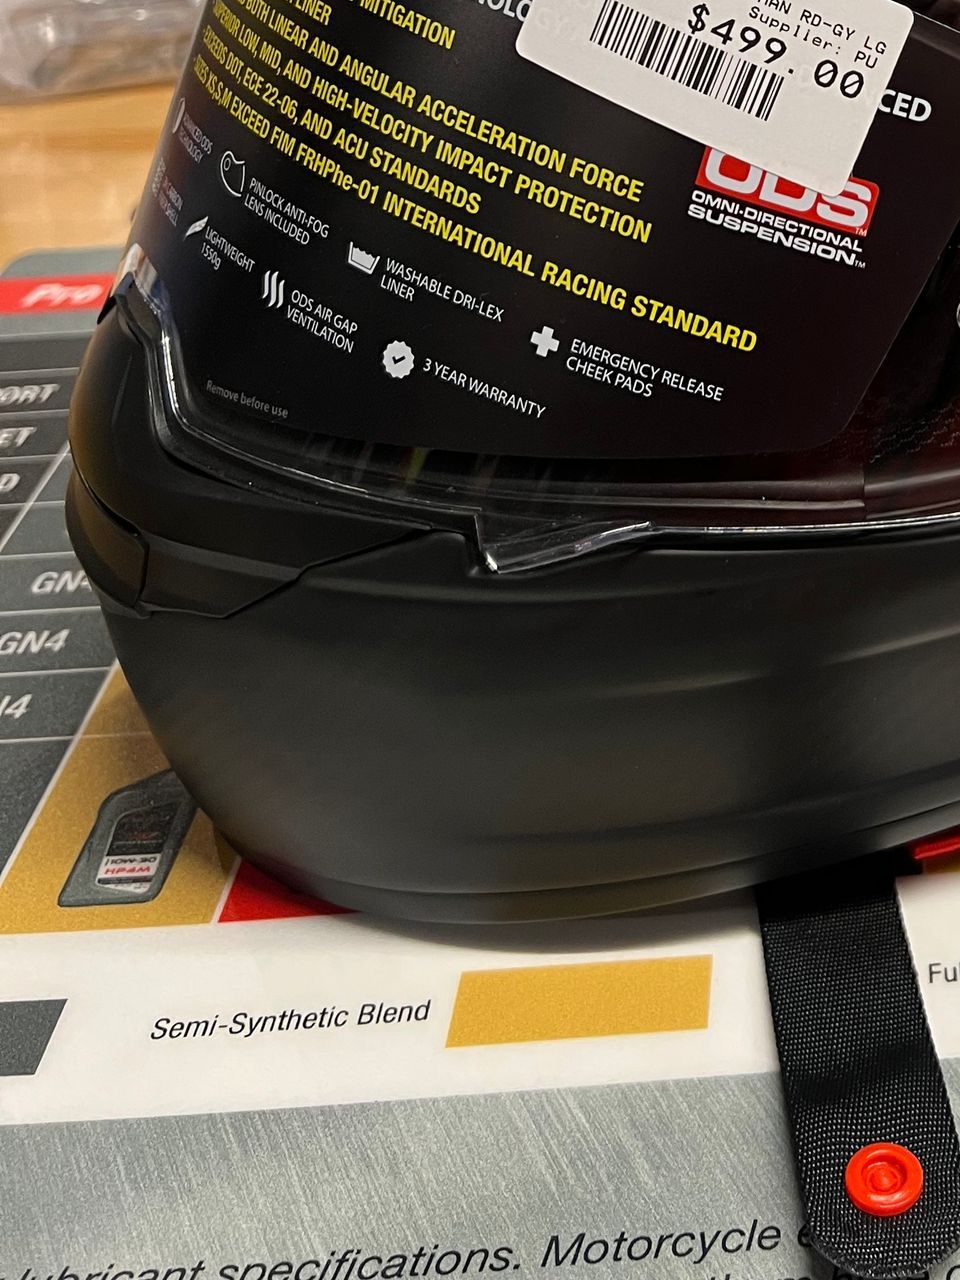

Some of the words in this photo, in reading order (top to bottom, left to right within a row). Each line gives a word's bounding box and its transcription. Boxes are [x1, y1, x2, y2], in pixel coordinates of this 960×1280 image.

[748, 6, 842, 56] Supplier:
[854, 50, 879, 69] PU
[800, 8, 856, 42] RD-GY
[863, 34, 887, 55] LG
[268, 8, 309, 50] LINEAR
[308, 40, 340, 67] AND
[339, 55, 418, 108] ANGULAR
[417, 94, 567, 174] ACCELERATION
[569, 157, 644, 202] FORCE
[225, 52, 243, 83] DOT,
[243, 68, 262, 96] ECE
[261, 82, 299, 125] 22-06,
[300, 108, 333, 139] AND
[333, 131, 369, 160] ACU
[369, 146, 482, 215] STANDARDS
[238, 26, 261, 59] LOW,
[259, 42, 282, 75] MID,
[283, 60, 310, 89] AND
[312, 76, 435, 153] HIGH-VELOCITY
[434, 139, 513, 188] IMPACT
[514, 174, 652, 243] PROTECTION
[230, 98, 271, 139] EXCEED
[270, 125, 295, 156] FIM
[296, 142, 379, 205] FRHPhe-01
[383, 189, 535, 277] INTERNATIONAL
[540, 261, 627, 310] RACING
[630, 295, 758, 352] STANDARD
[244, 194, 265, 218] LENS
[264, 210, 310, 245] INCLUDED
[250, 178, 284, 211] PINLOCK
[283, 200, 330, 238] ANTI-FOG
[691, 190, 863, 252] OMNI-DIRECTIONAL
[205, 226, 255, 272] LIGHTWEIGHT
[20, 283, 103, 308] Pro
[291, 289, 314, 312] ODS
[314, 302, 333, 323] AIR
[332, 312, 358, 335] GAP
[381, 275, 415, 302] LINER
[386, 257, 452, 300] WASHABLE
[453, 289, 505, 322] DRI-LEX
[287, 307, 355, 354] VENTILATION
[0, 384, 60, 406] ORT
[422, 357, 432, 373] 3
[434, 361, 468, 388] YEAR
[468, 375, 547, 420] WARRANTY
[566, 356, 615, 387] CHEEK
[615, 372, 654, 398] PADS
[570, 338, 660, 381] EMERGENCY
[660, 368, 725, 403] RELEASE
[205, 379, 239, 402] Remove
[240, 391, 270, 413] before
[271, 403, 289, 419] use
[149, 1006, 349, 1042] Semi-Synthetic
[356, 999, 431, 1026] Blend
[218, 1243, 521, 1280] specifications.
[540, 1219, 782, 1267] Motorcycle
